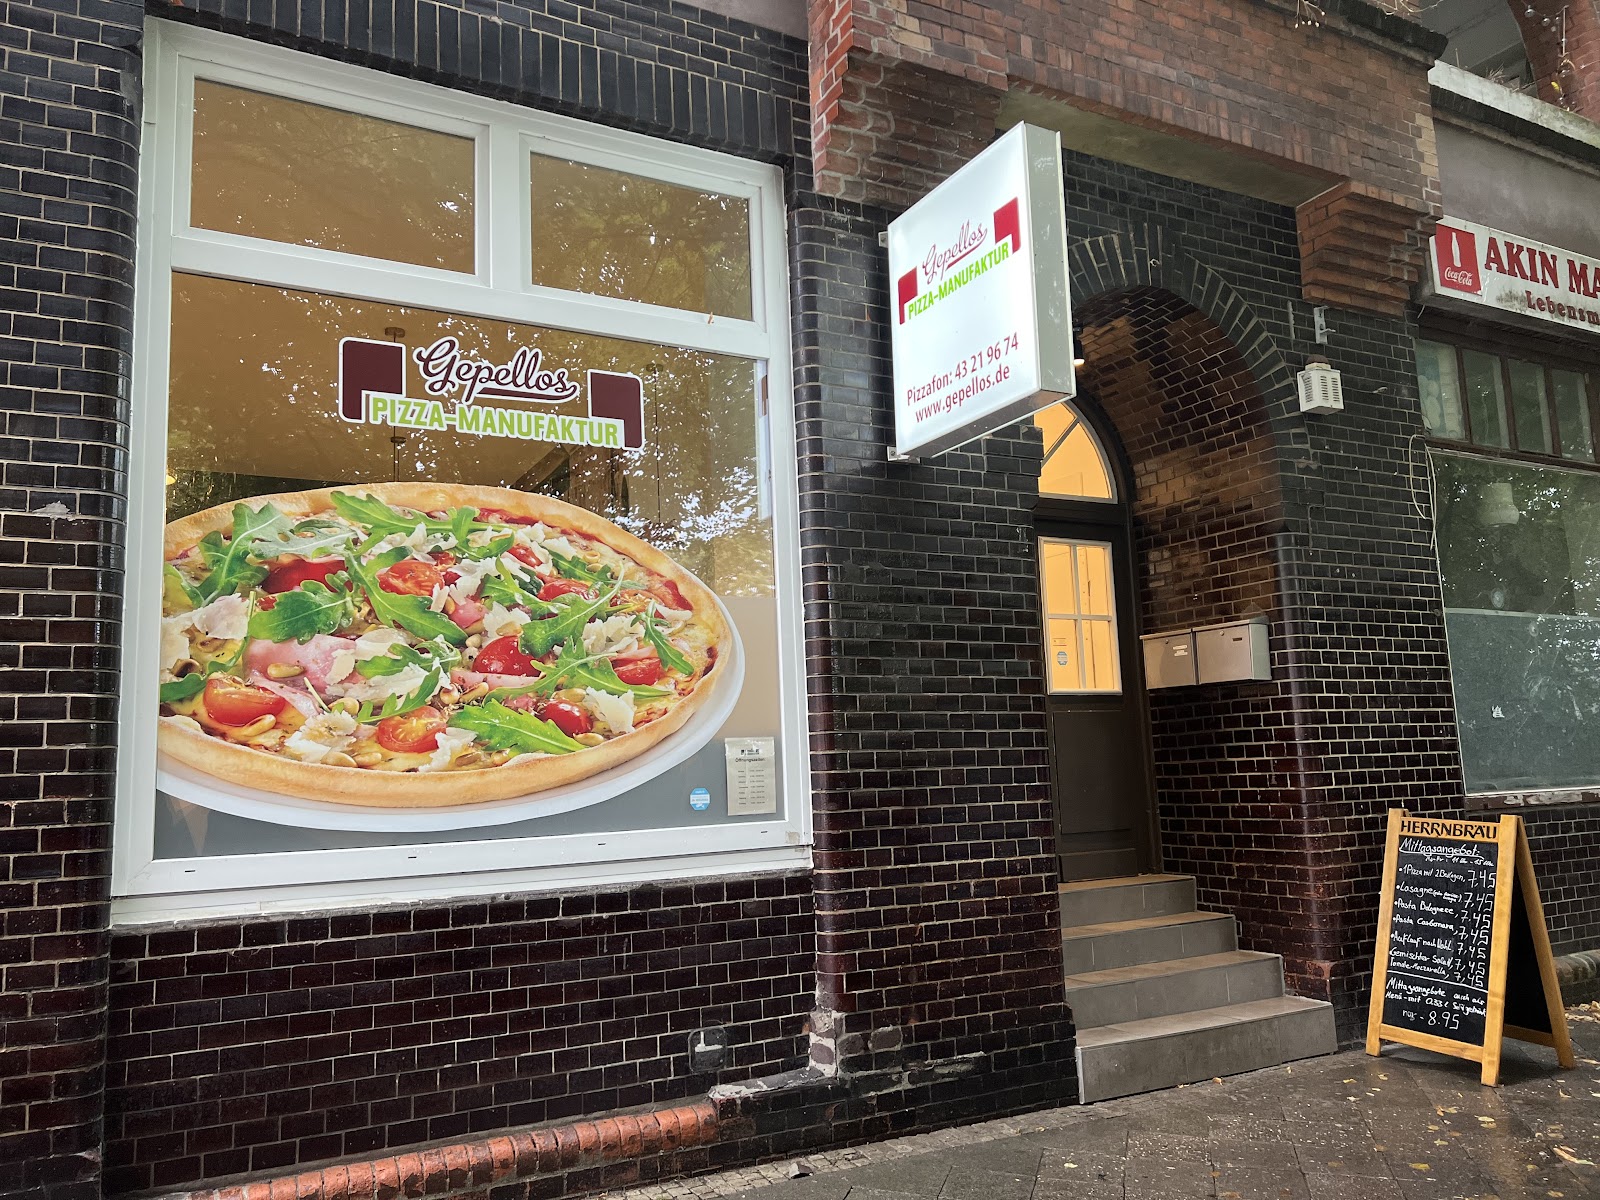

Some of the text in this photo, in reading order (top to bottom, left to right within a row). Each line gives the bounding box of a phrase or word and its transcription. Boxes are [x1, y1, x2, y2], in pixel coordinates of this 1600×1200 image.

[922, 219, 988, 285] Gepellos
[1484, 236, 1559, 288] AKIN
[908, 241, 1009, 320] PIZZA-MANUFAKTUR
[1444, 266, 1473, 286] Coca-Cola
[416, 339, 577, 402] Gepellos
[907, 332, 1019, 406] Pizzafon: 43 21 96 74
[915, 364, 1010, 423] www.gepellos.de
[373, 397, 618, 446] PIZZA-MANUFAKTUR
[1401, 820, 1497, 839] HERRNBRÄU
[1400, 838, 1480, 858] Mittagsangebot:
[1468, 869, 1497, 888] 7,45
[1397, 897, 1416, 910] Pasta
[1464, 892, 1494, 912] 7,45
[1396, 914, 1413, 925] Pasta
[1459, 926, 1489, 946] 7,45
[1457, 943, 1486, 960] 7,45
[1455, 958, 1485, 976] 7,45
[1454, 971, 1484, 988] 7,45
